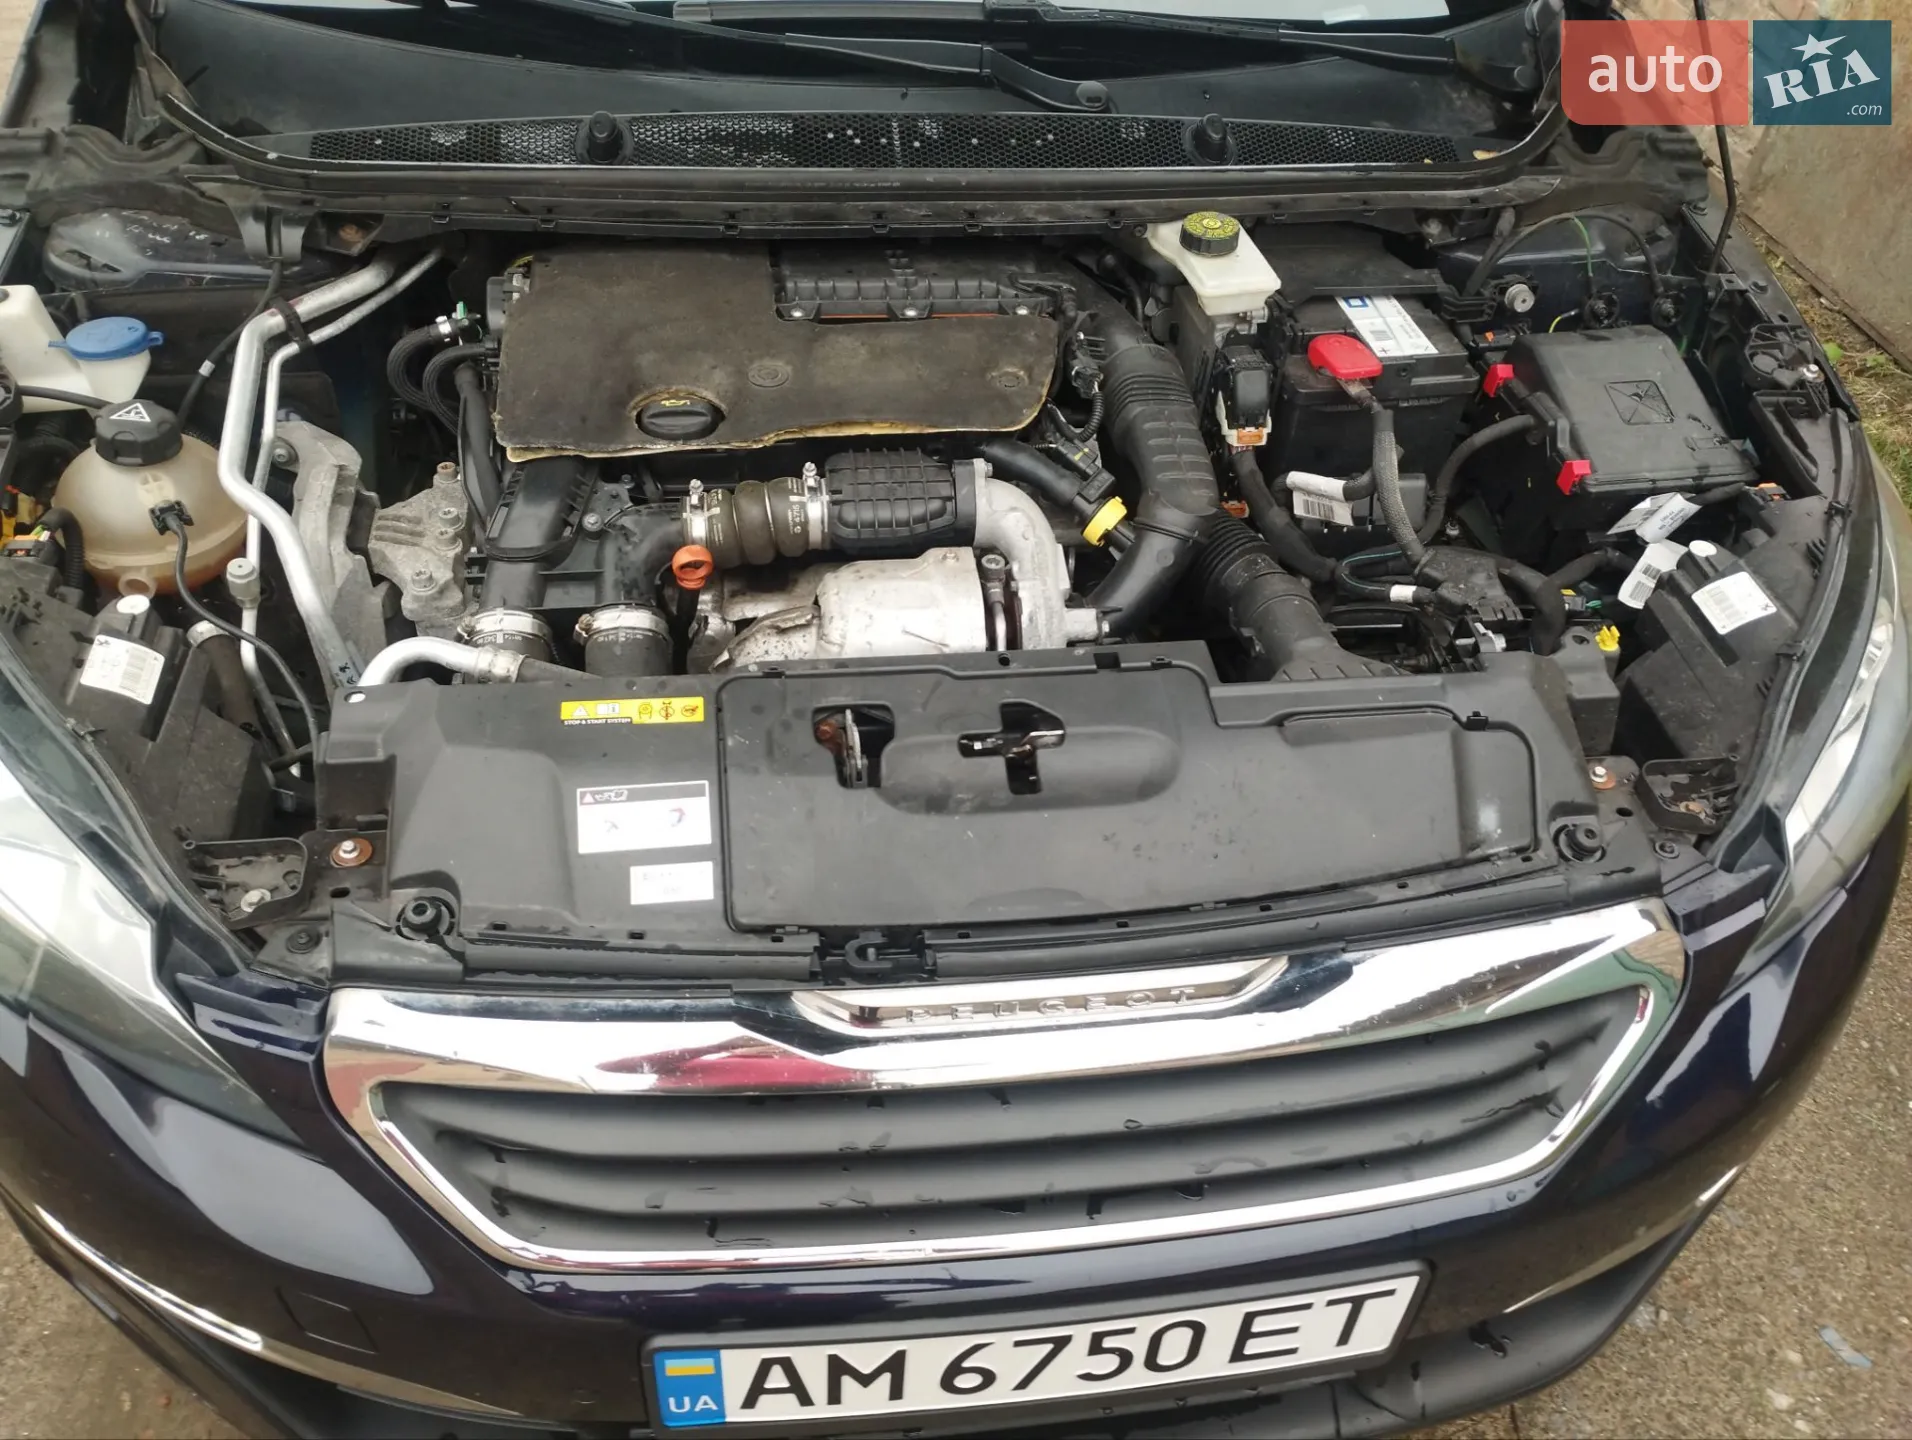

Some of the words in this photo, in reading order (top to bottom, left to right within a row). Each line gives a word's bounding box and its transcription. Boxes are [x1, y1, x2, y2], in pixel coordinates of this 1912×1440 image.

[906, 986, 1196, 1022] PEUGEOT
[739, 1348, 906, 1410] AM
[939, 1319, 1207, 1396] 6750
[1228, 1288, 1398, 1364] ET
[668, 1394, 719, 1414] UA
